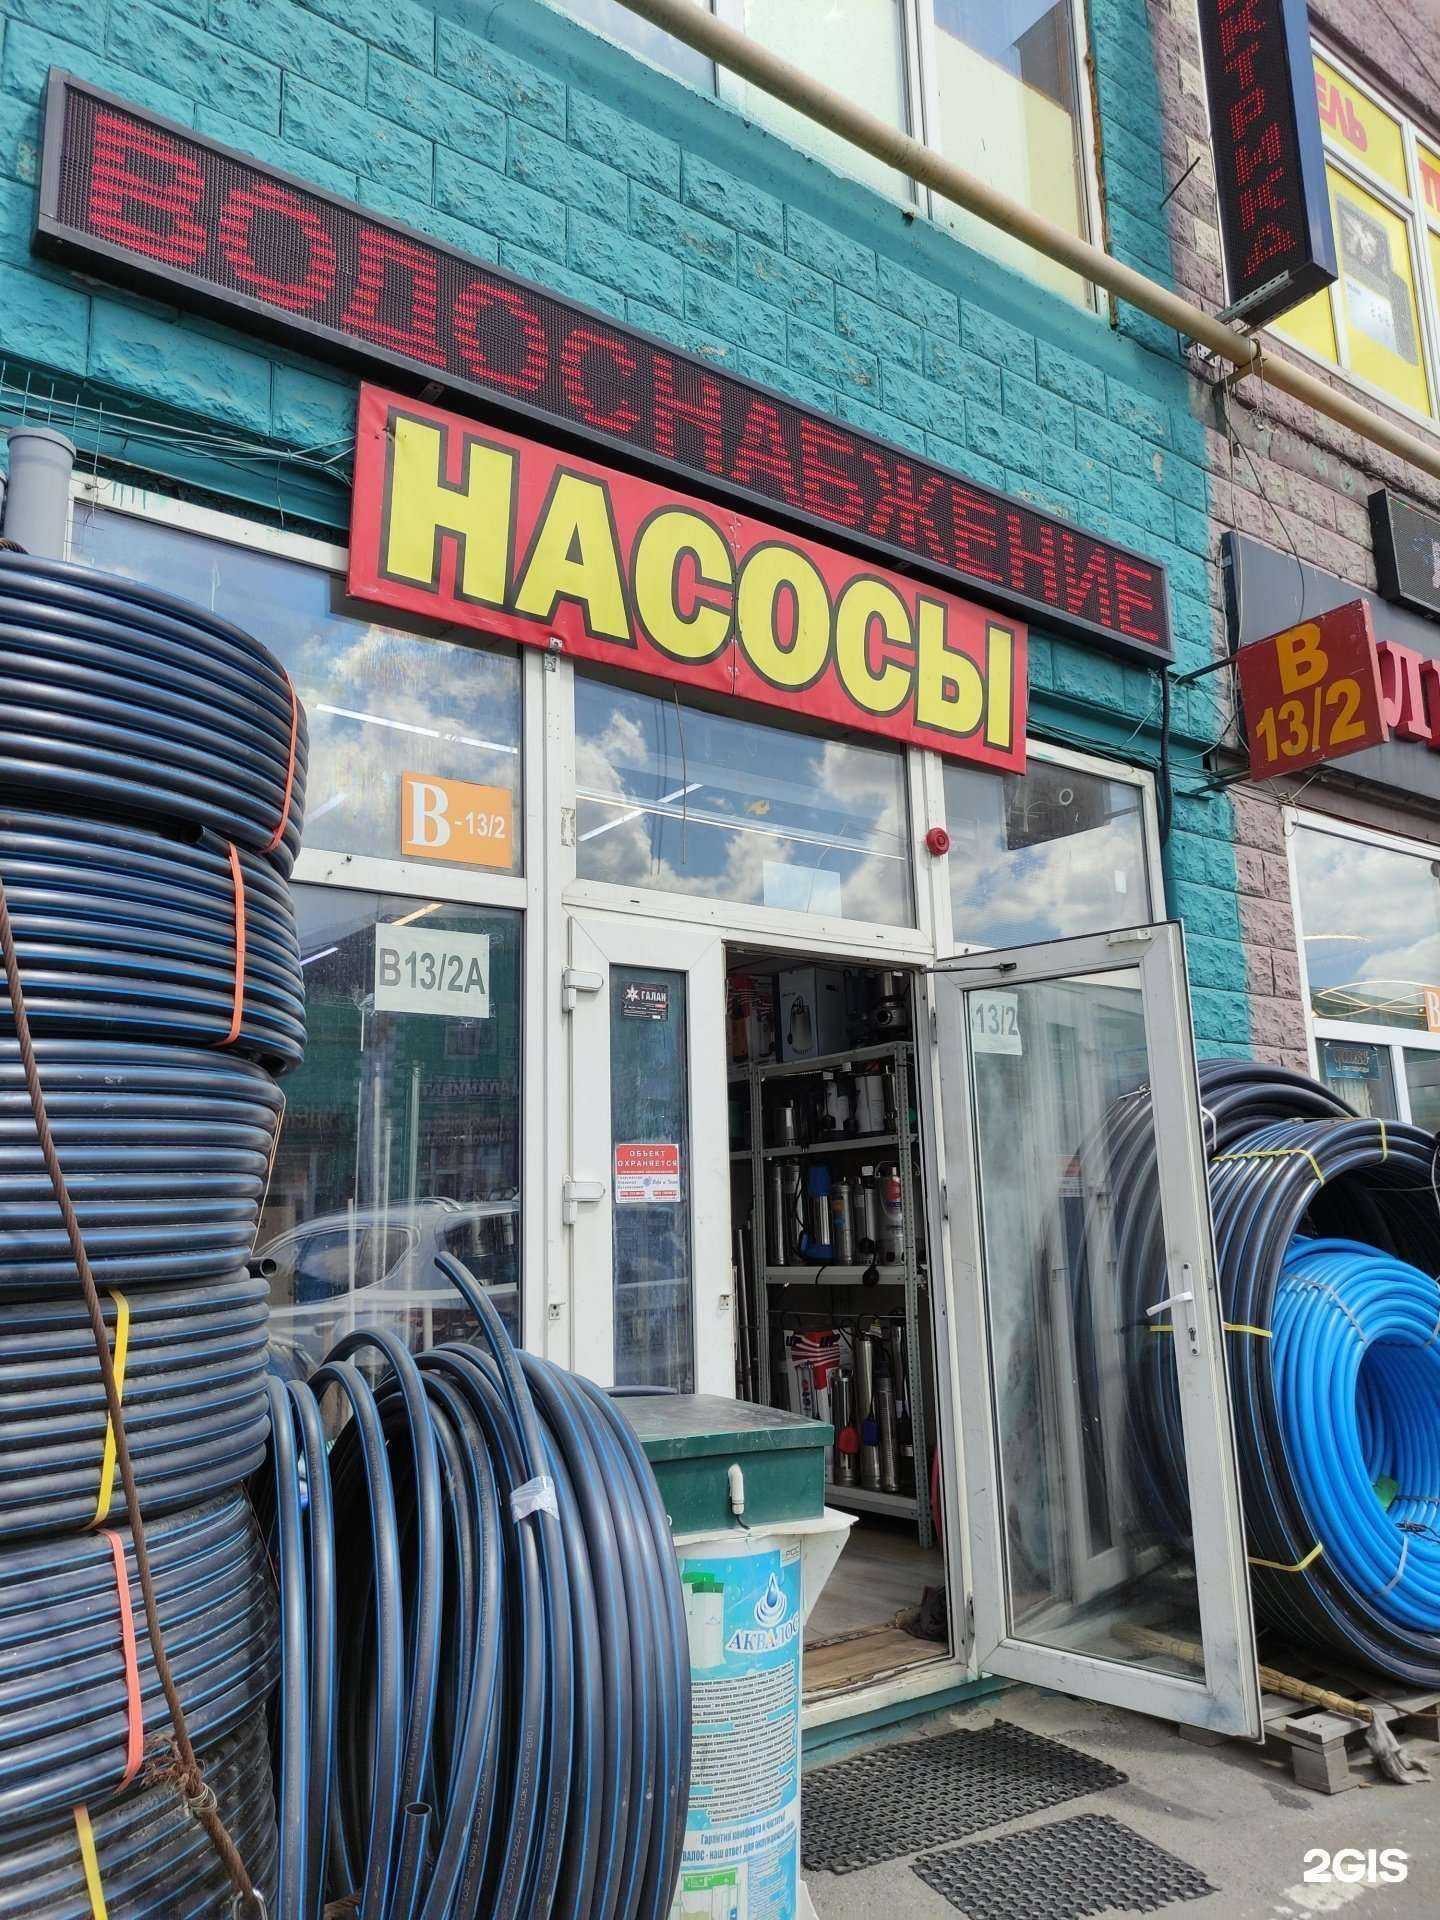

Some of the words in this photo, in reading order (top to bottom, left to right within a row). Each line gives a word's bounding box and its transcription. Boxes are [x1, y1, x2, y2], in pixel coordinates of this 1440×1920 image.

[1216, 0, 1297, 279] КТРИКА
[88, 113, 1159, 641] ВОДОСНАБЖЕНИЕ
[383, 411, 1016, 752] НАСОСЫ
[1256, 678, 1366, 762] 13/2
[728, 1613, 799, 1650] АКВАЛОС
